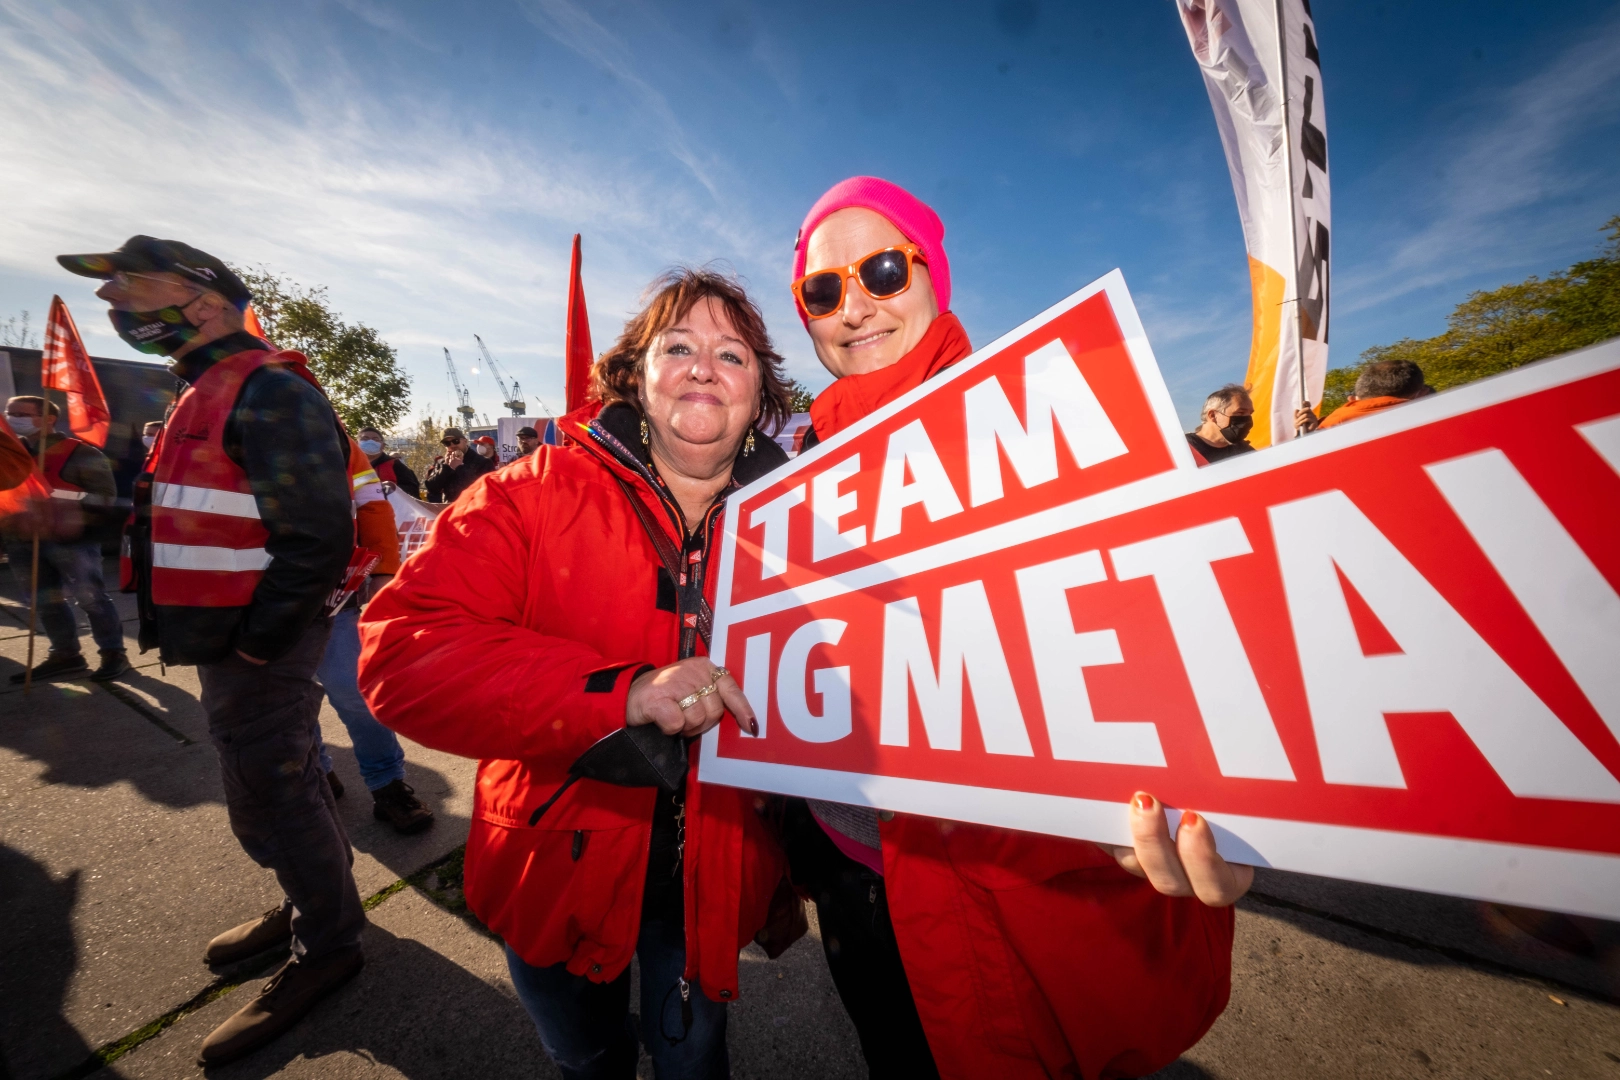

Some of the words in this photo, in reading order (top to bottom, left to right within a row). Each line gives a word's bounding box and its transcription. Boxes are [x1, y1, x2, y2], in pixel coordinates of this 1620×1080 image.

[739, 618, 853, 744] IG
[880, 412, 1620, 805] METAL
[749, 337, 1129, 581] TEAM
